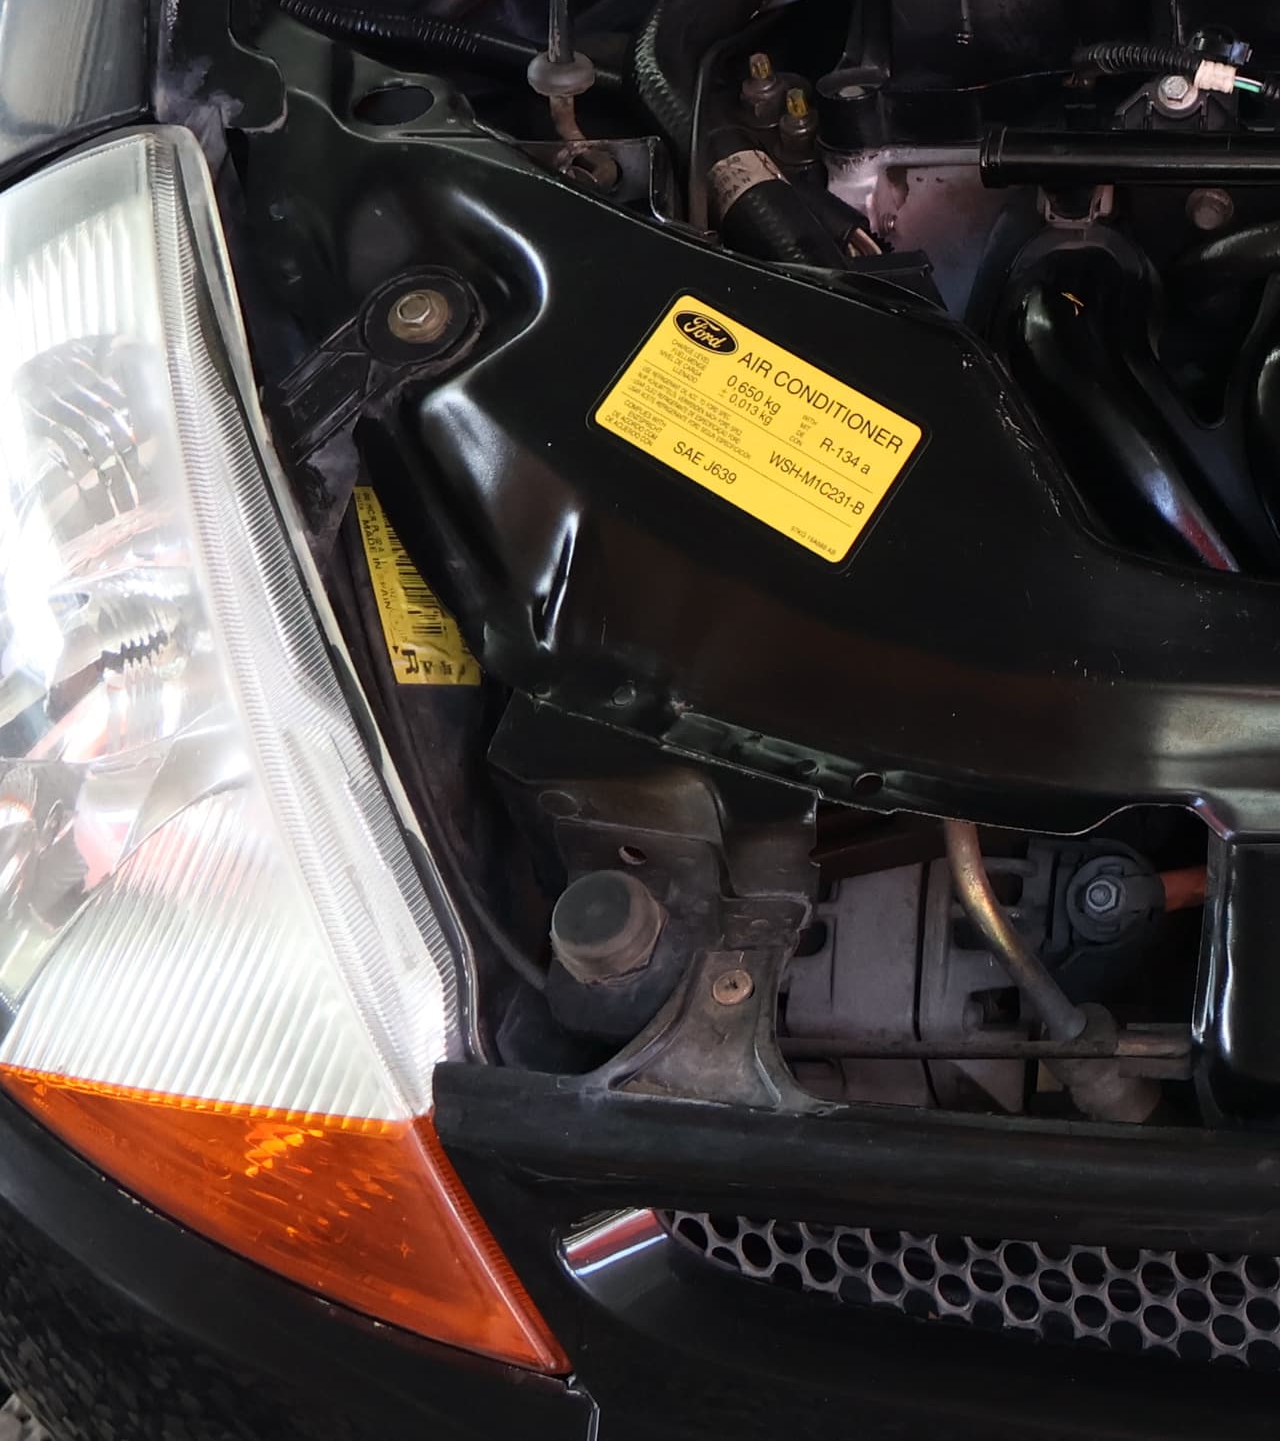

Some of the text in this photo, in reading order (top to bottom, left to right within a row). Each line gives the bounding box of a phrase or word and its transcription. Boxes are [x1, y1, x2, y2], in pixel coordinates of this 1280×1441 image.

[683, 316, 728, 349] Ford
[737, 351, 903, 453] AIR CONDITIONER
[757, 409, 774, 427] kg
[762, 395, 782, 416] kg
[672, 440, 737, 485] SAE J639
[818, 436, 871, 475] R-134 a
[768, 450, 865, 515] WSH-M1C231-B
[361, 518, 378, 554] MADE
[372, 556, 382, 570] IN
